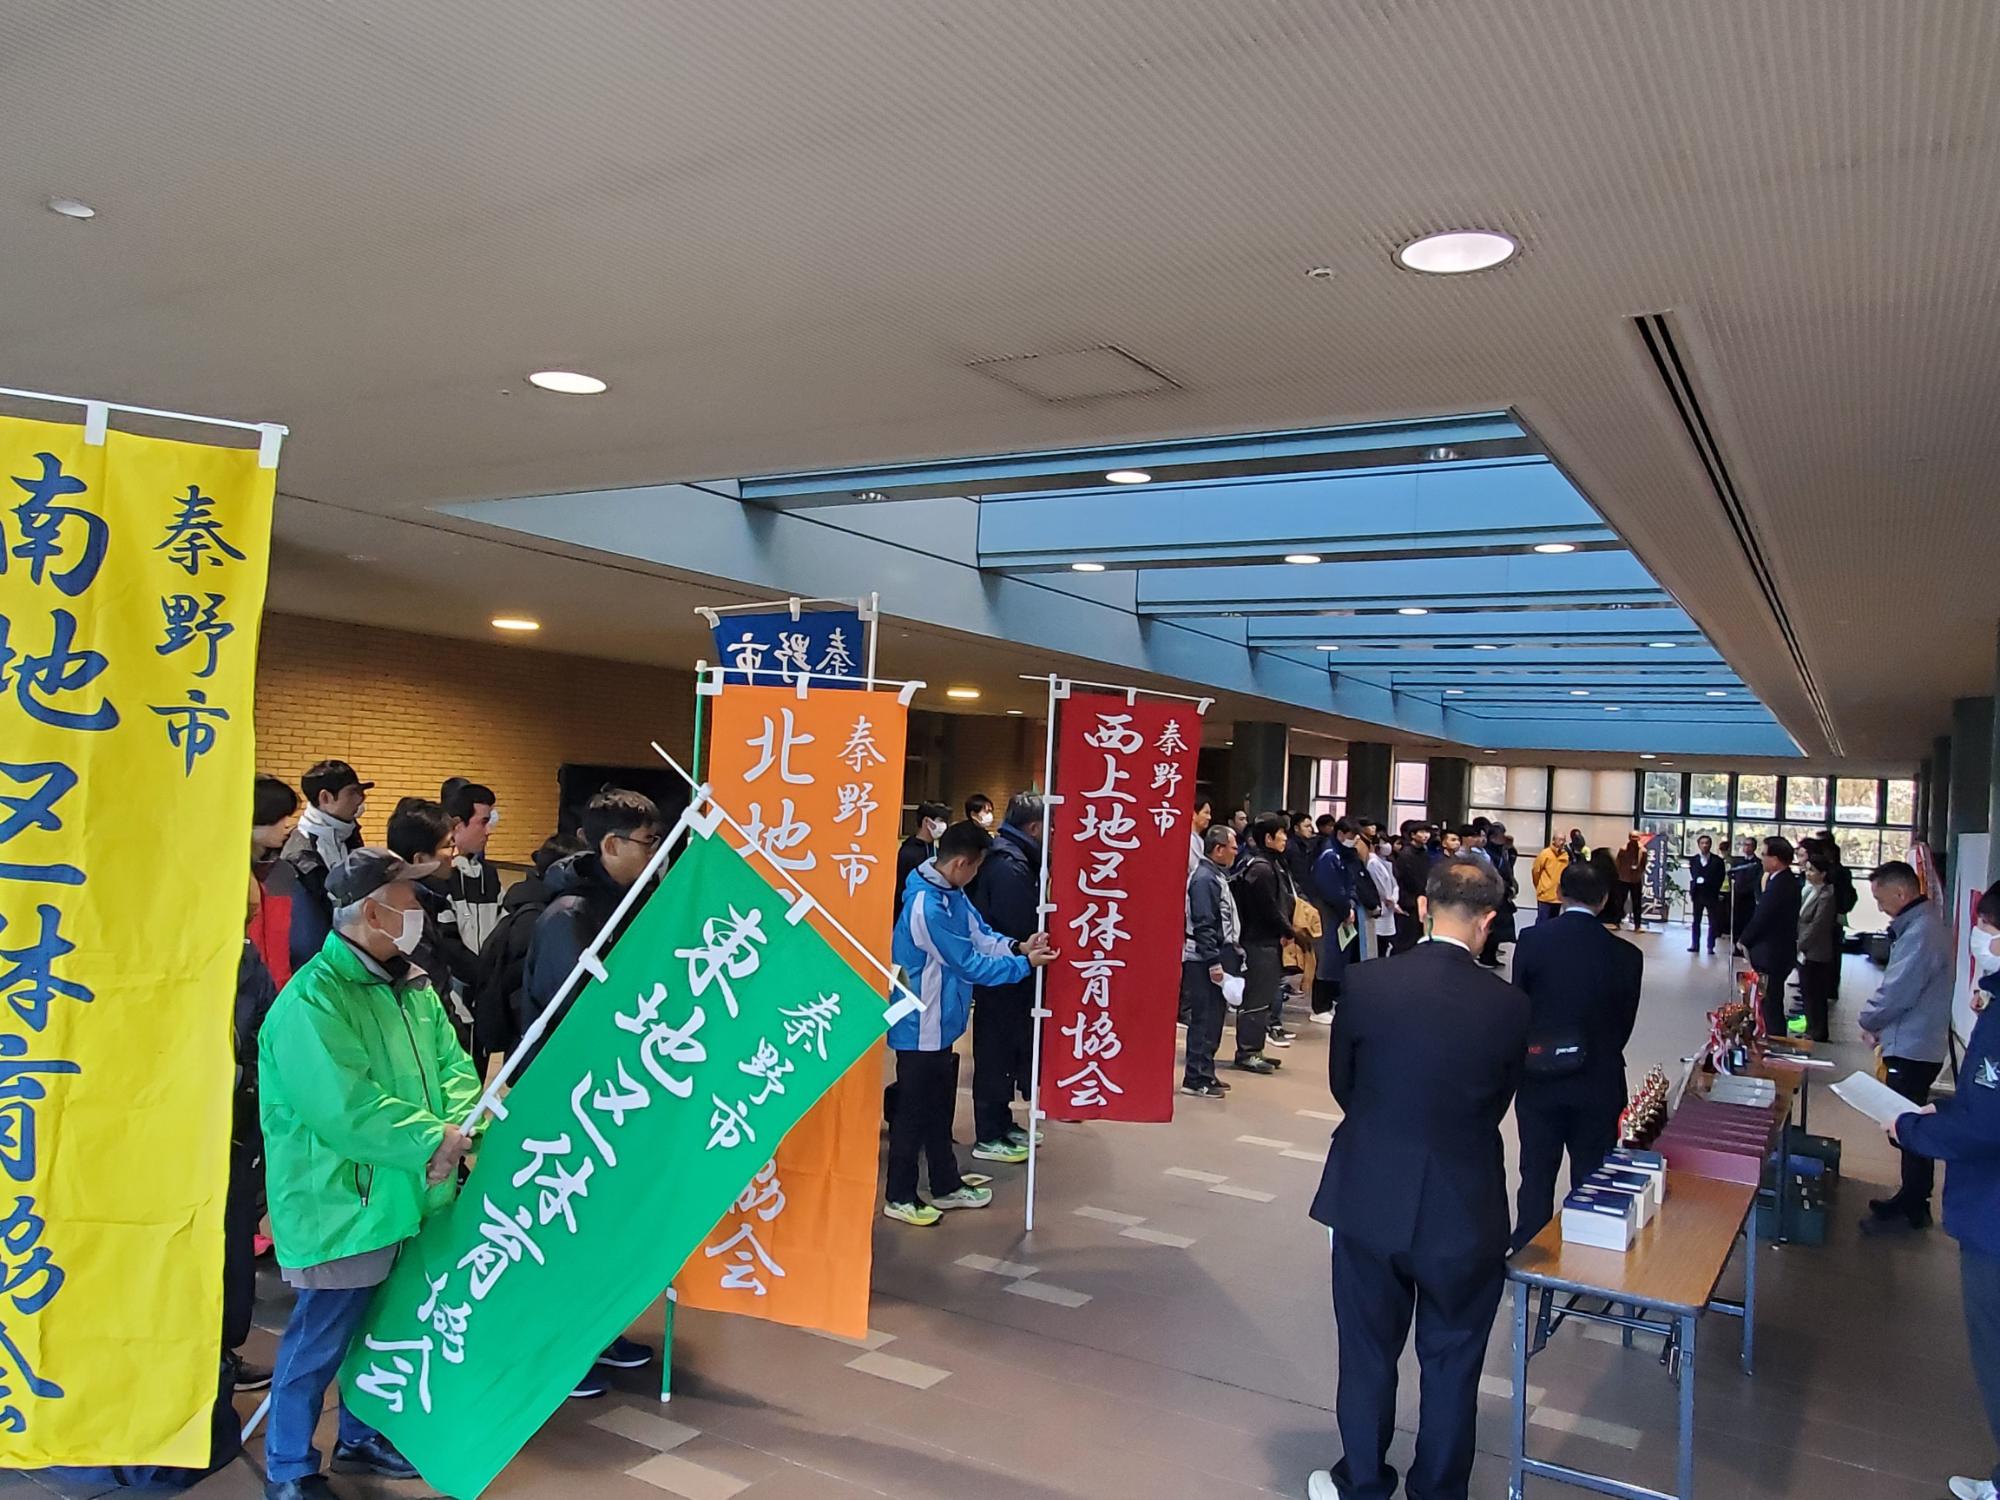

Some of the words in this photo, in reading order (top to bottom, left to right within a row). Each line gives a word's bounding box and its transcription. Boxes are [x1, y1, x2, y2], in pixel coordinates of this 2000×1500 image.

[147, 484, 247, 778] 秦野市
[830, 714, 887, 898] 秦野市
[1147, 718, 1189, 839] 秦野市
[1057, 712, 1145, 1109] 西上地区体育協会
[354, 902, 768, 1414] 東地区体育協会
[706, 990, 843, 1151] 秦野市
